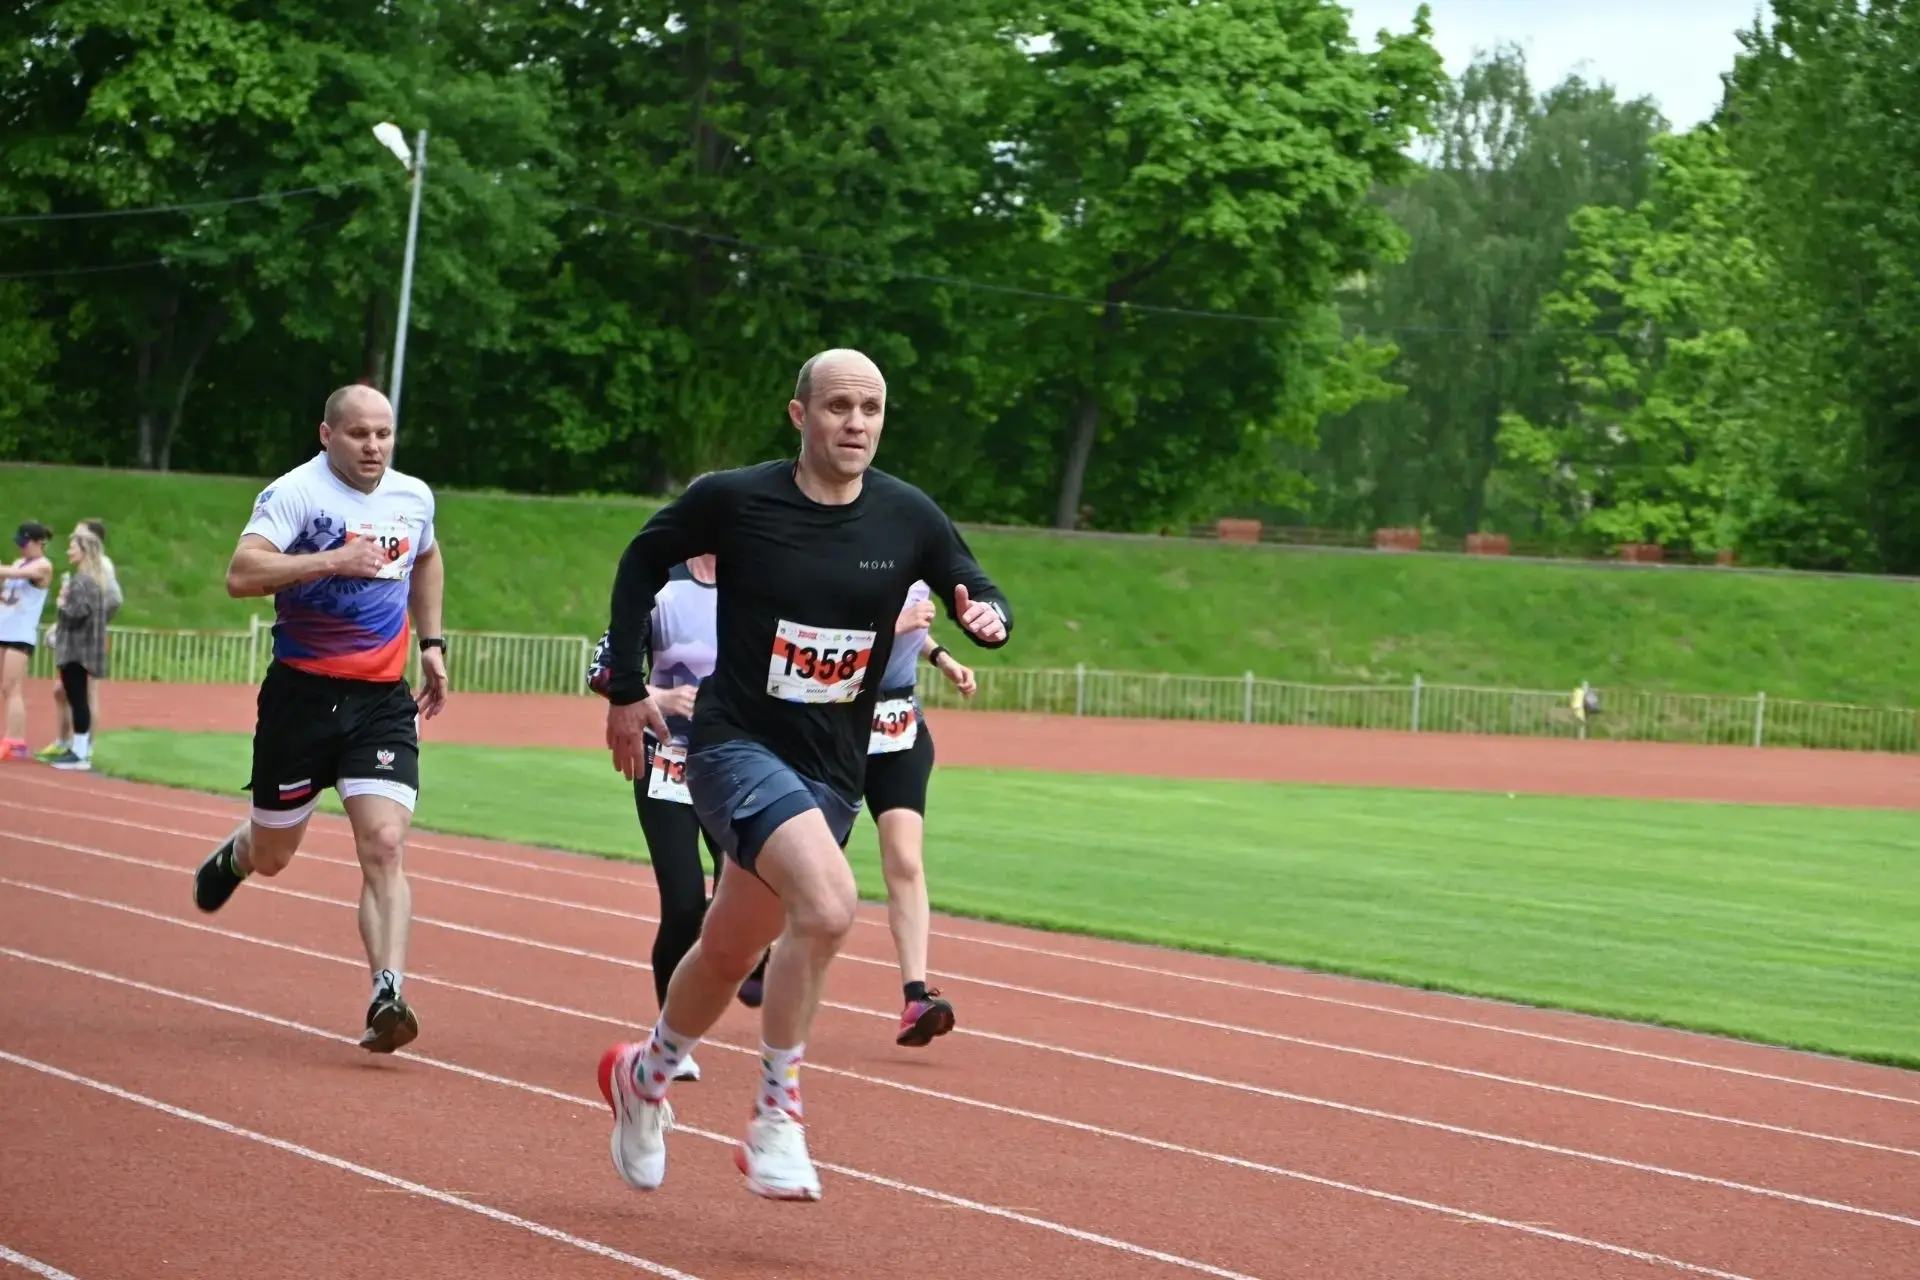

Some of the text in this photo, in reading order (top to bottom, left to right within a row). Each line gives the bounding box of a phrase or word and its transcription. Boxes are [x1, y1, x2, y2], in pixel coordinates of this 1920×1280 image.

[380, 536, 400, 562] 18
[783, 642, 858, 680] 1358
[872, 711, 909, 736] 439
[662, 759, 687, 784] 13
